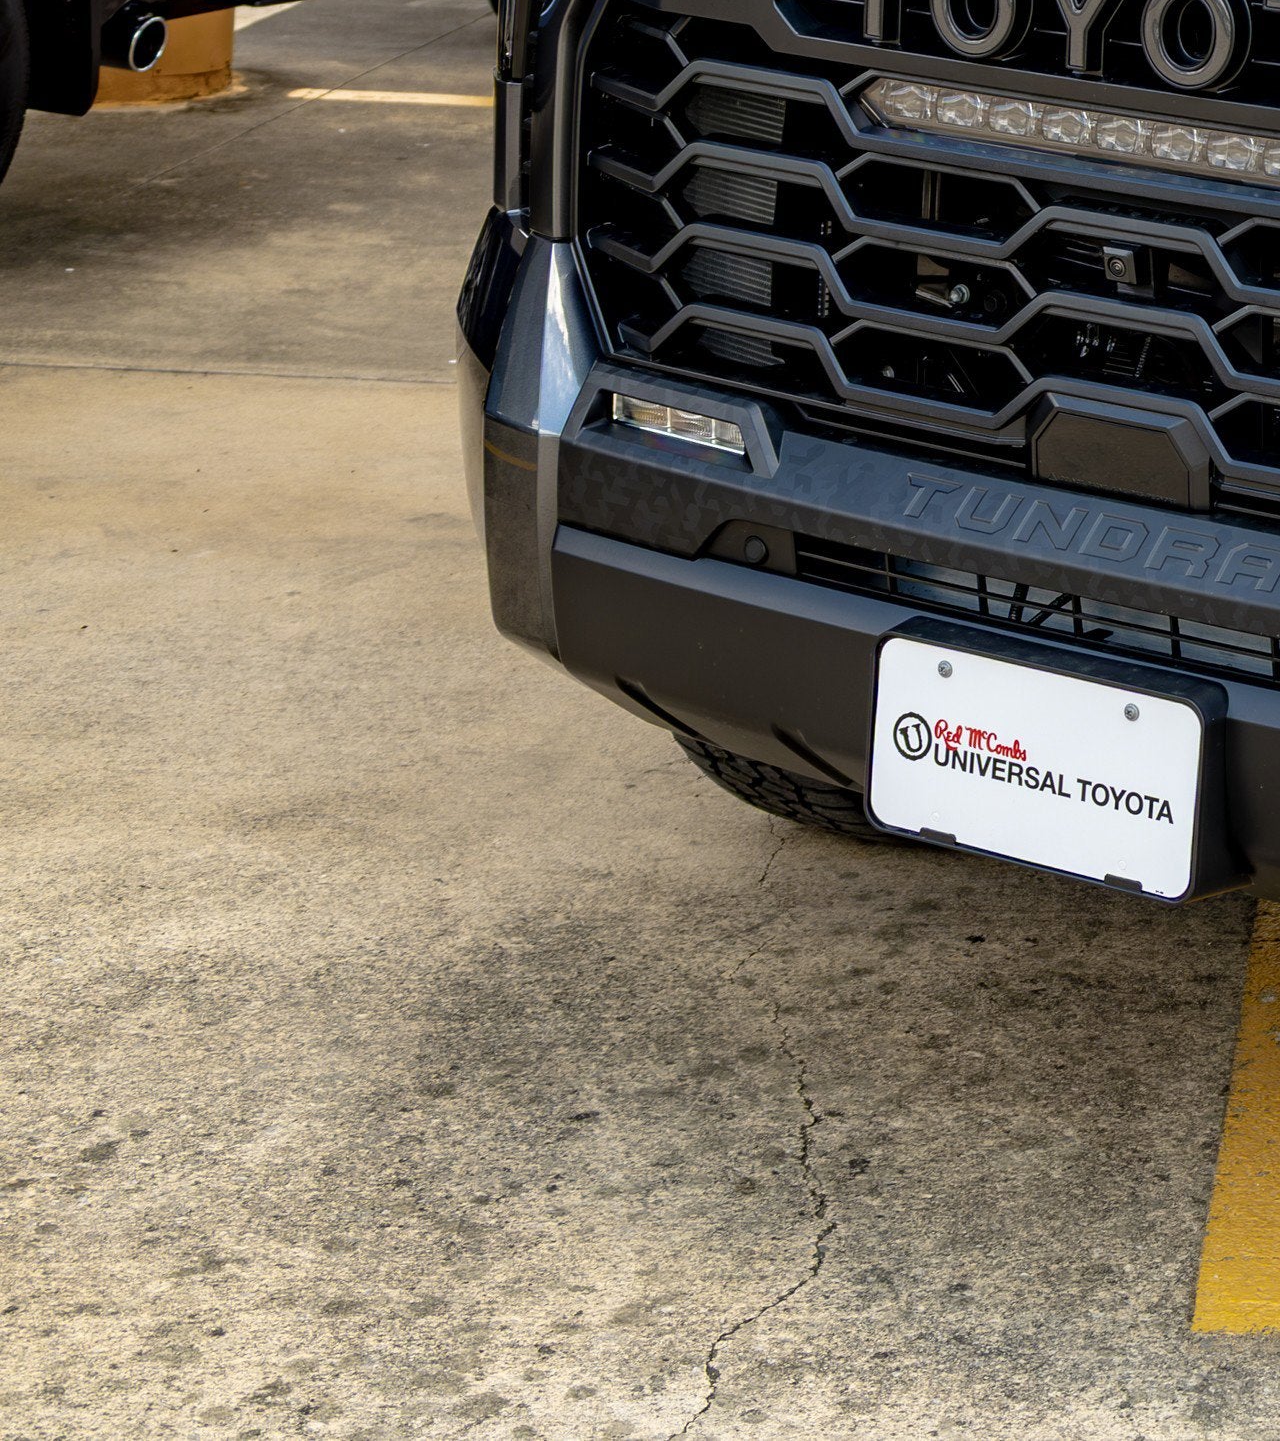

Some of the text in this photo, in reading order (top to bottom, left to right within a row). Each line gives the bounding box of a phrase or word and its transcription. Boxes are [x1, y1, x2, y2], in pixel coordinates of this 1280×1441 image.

[934, 719, 1027, 762] Red McCombs
[934, 742, 1174, 825] UNIVERSAL TOYOTA
